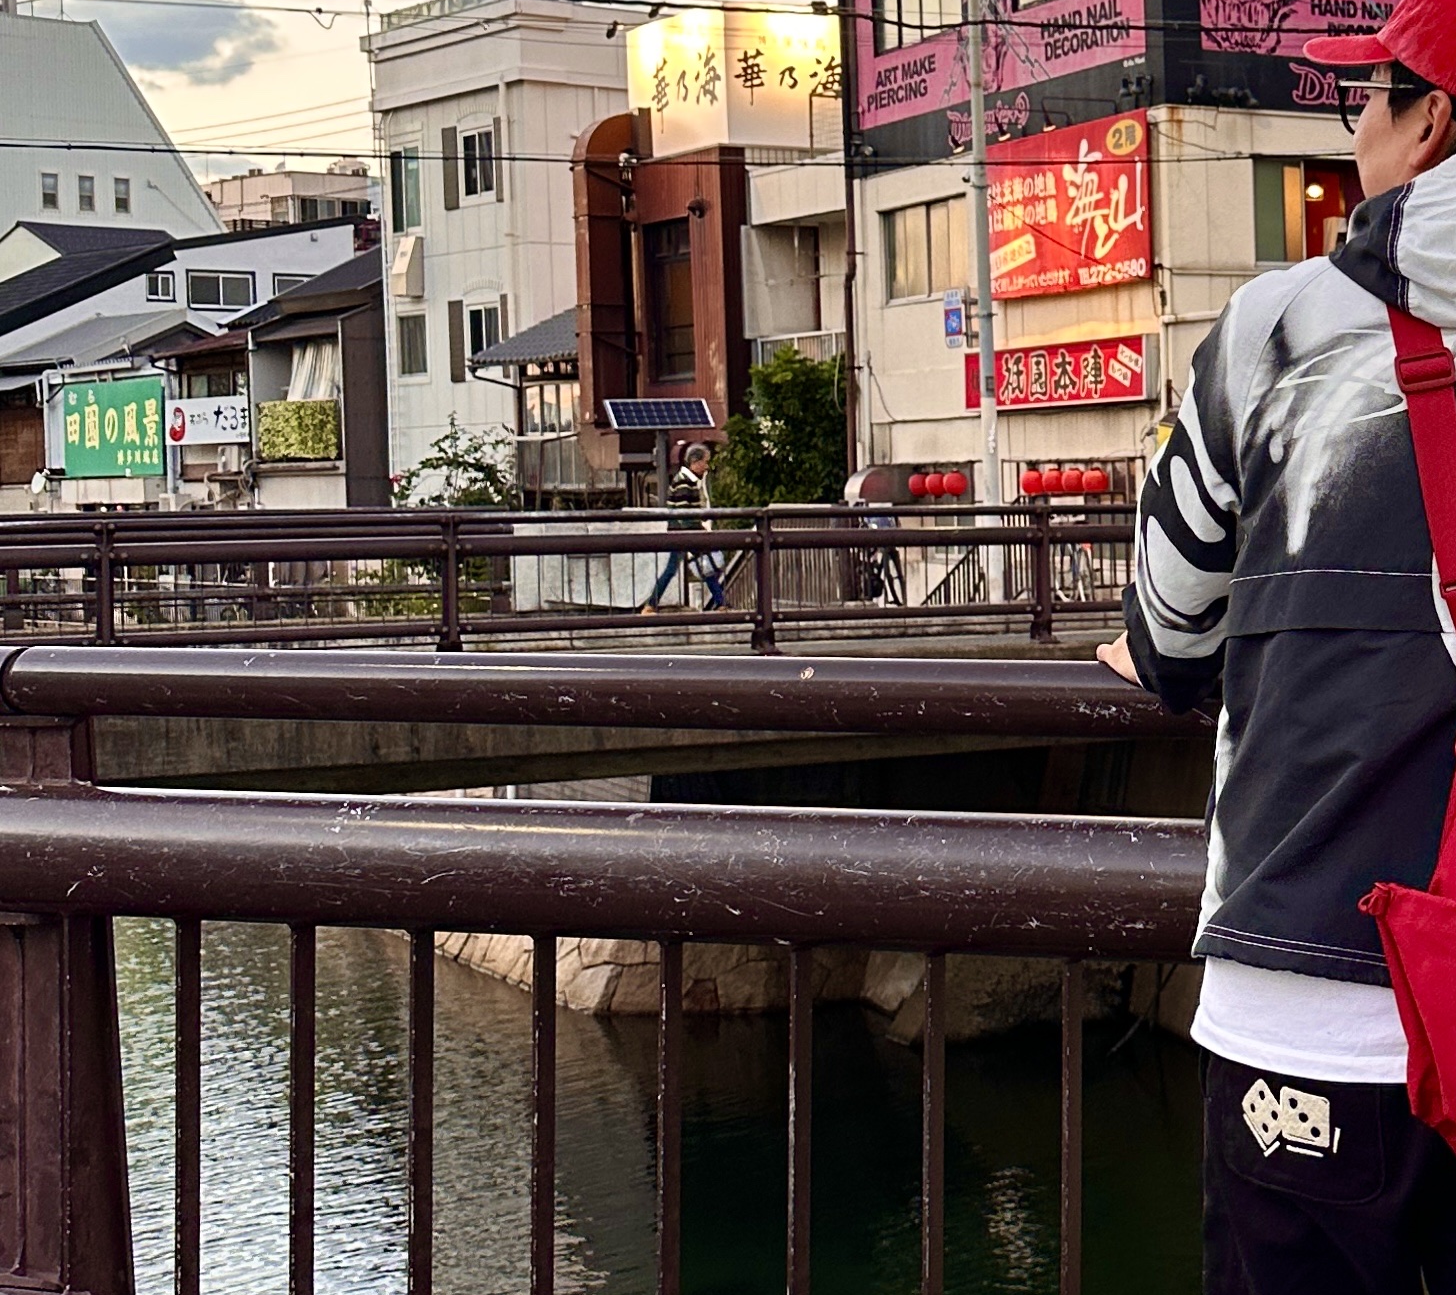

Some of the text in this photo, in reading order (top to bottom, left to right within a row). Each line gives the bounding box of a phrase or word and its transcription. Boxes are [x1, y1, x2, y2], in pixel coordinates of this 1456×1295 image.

[1039, 4, 1083, 41] HAND
[1044, 17, 1131, 63] DECORATION
[875, 53, 937, 91] ART MAKE
[866, 78, 929, 114] PIERCING
